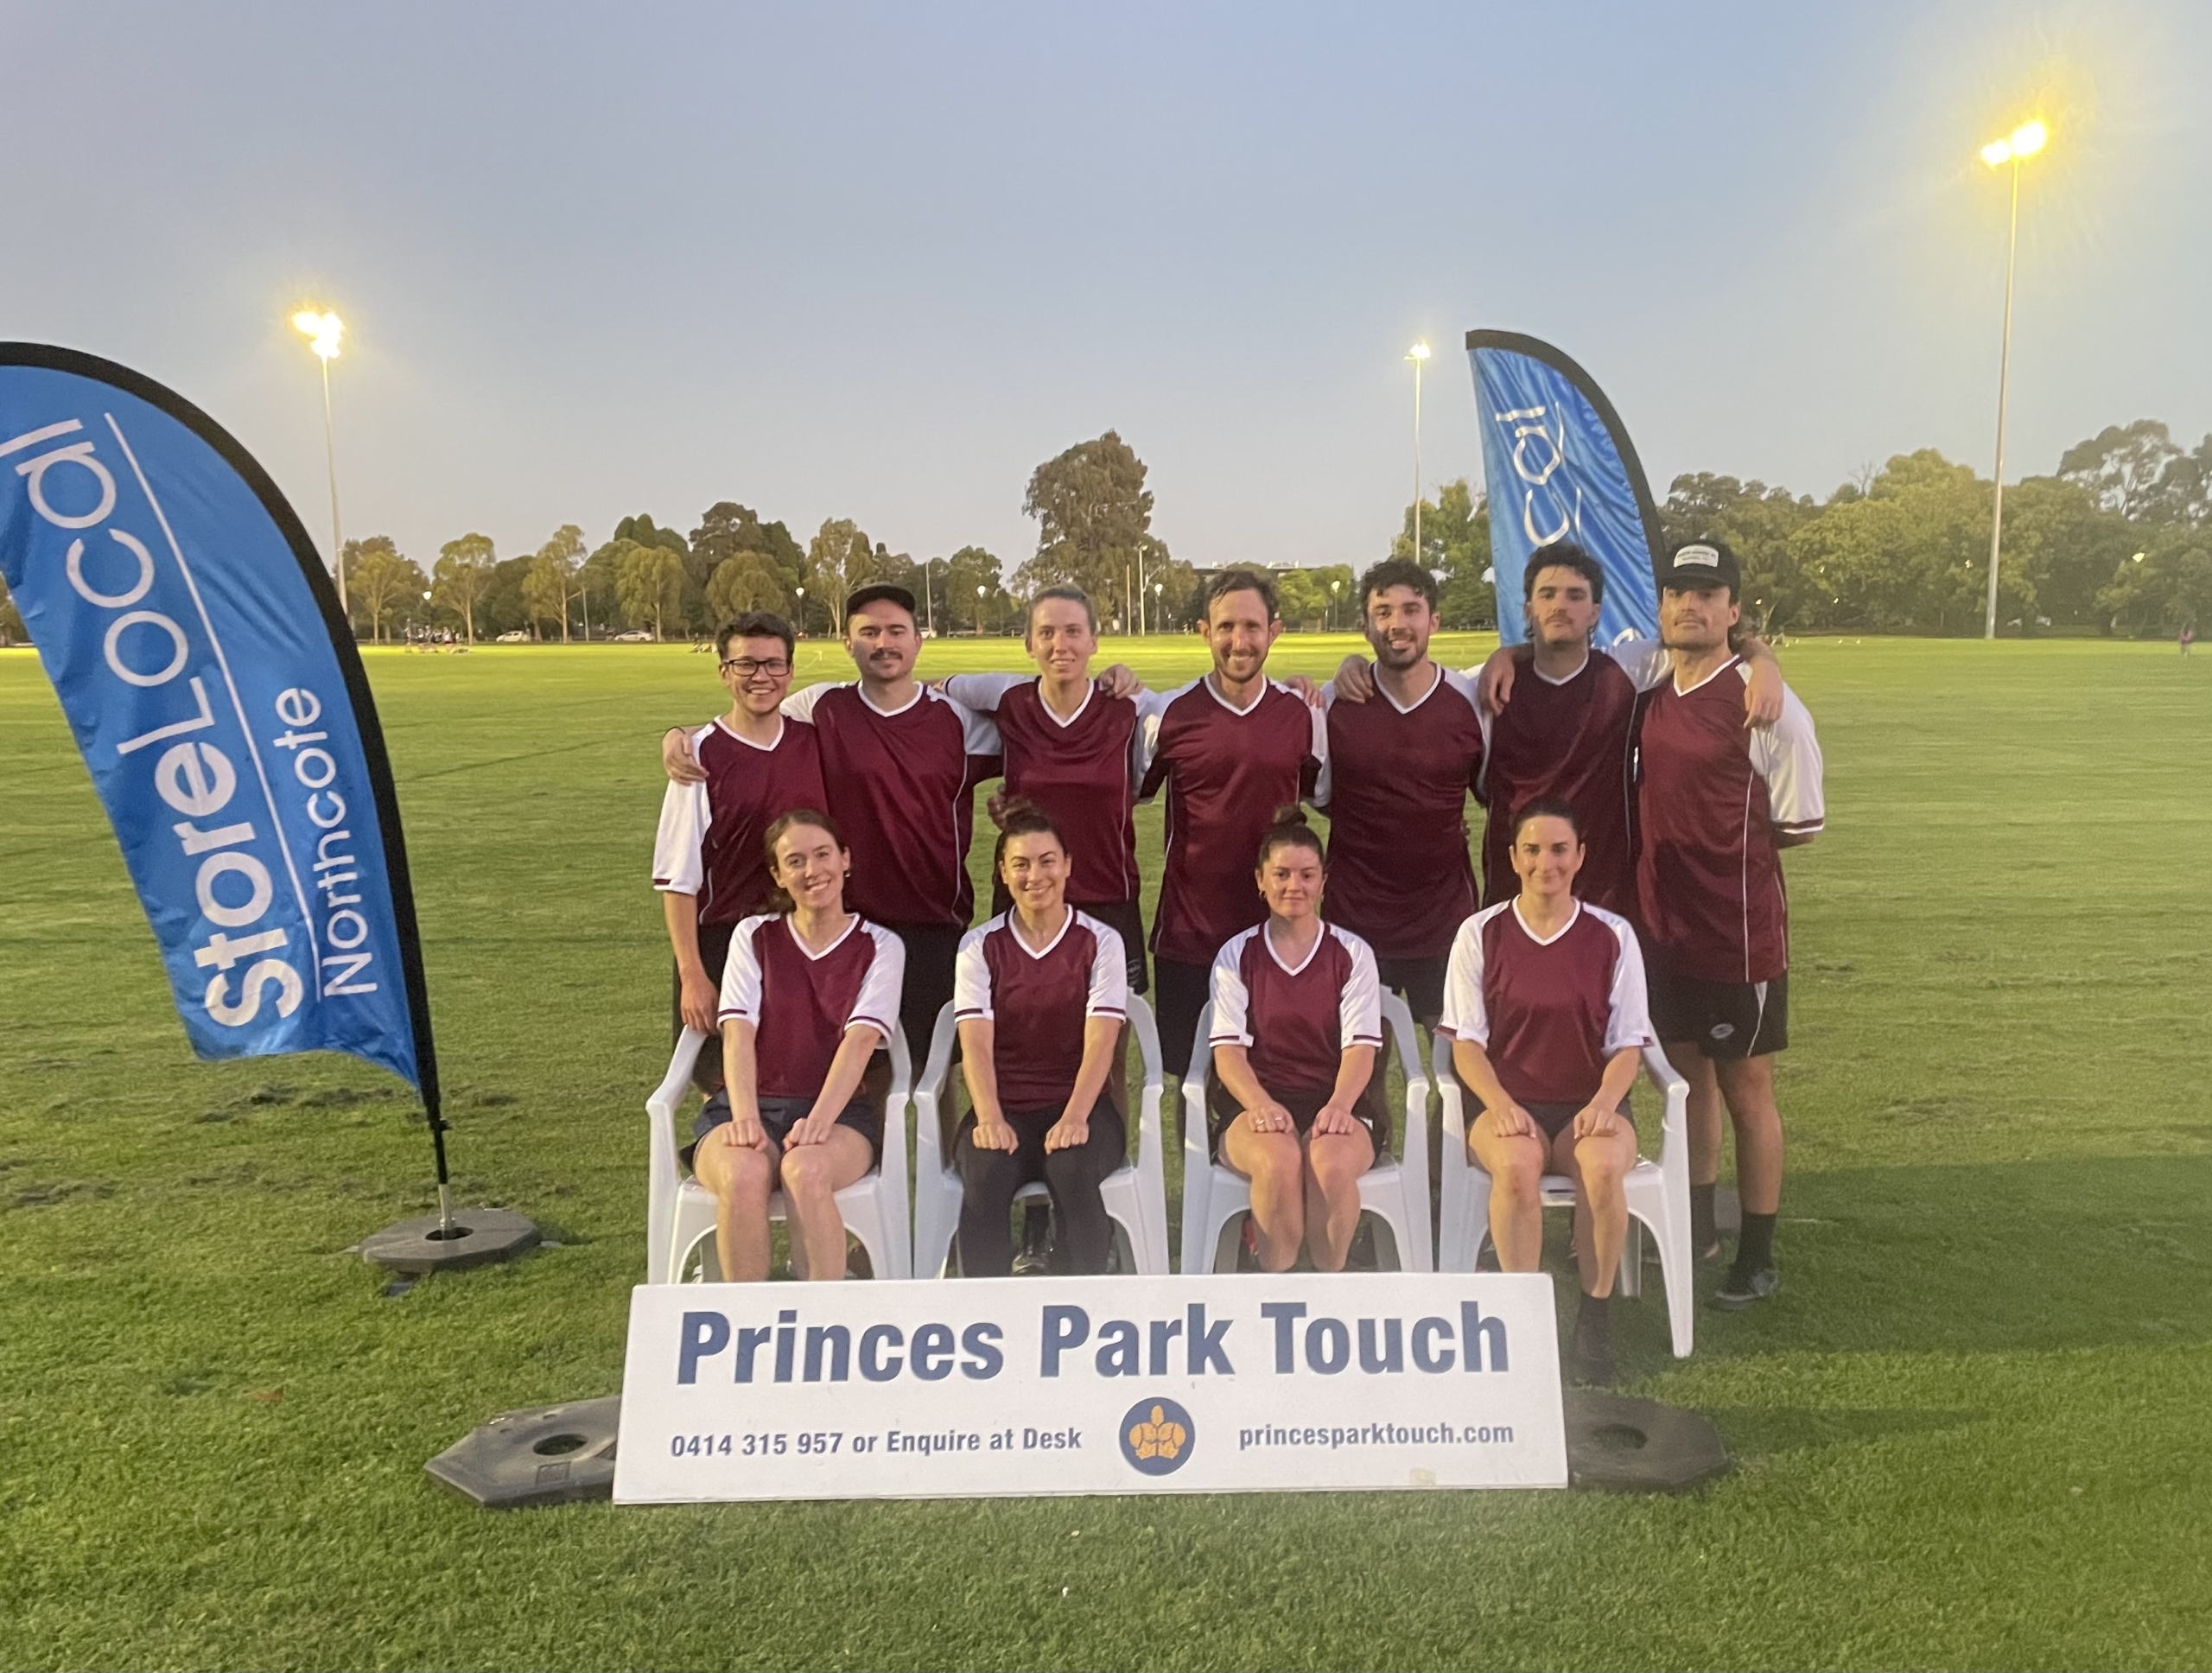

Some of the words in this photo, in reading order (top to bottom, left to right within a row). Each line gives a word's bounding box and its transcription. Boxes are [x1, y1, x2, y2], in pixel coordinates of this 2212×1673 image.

[0, 418, 303, 1027] StoreLocal
[273, 687, 378, 996] Northcote
[677, 1309, 1004, 1385] Princes
[1039, 1303, 1236, 1377] Park
[1261, 1301, 1509, 1375] Touch
[671, 1434, 732, 1457] 0414
[742, 1434, 787, 1455] 315
[797, 1432, 843, 1454] 957
[852, 1436, 878, 1453] or
[887, 1429, 980, 1456] Enquire
[989, 1428, 1014, 1450] at
[1023, 1428, 1082, 1449] Desk
[1239, 1422, 1515, 1451] princesparktouch.com
